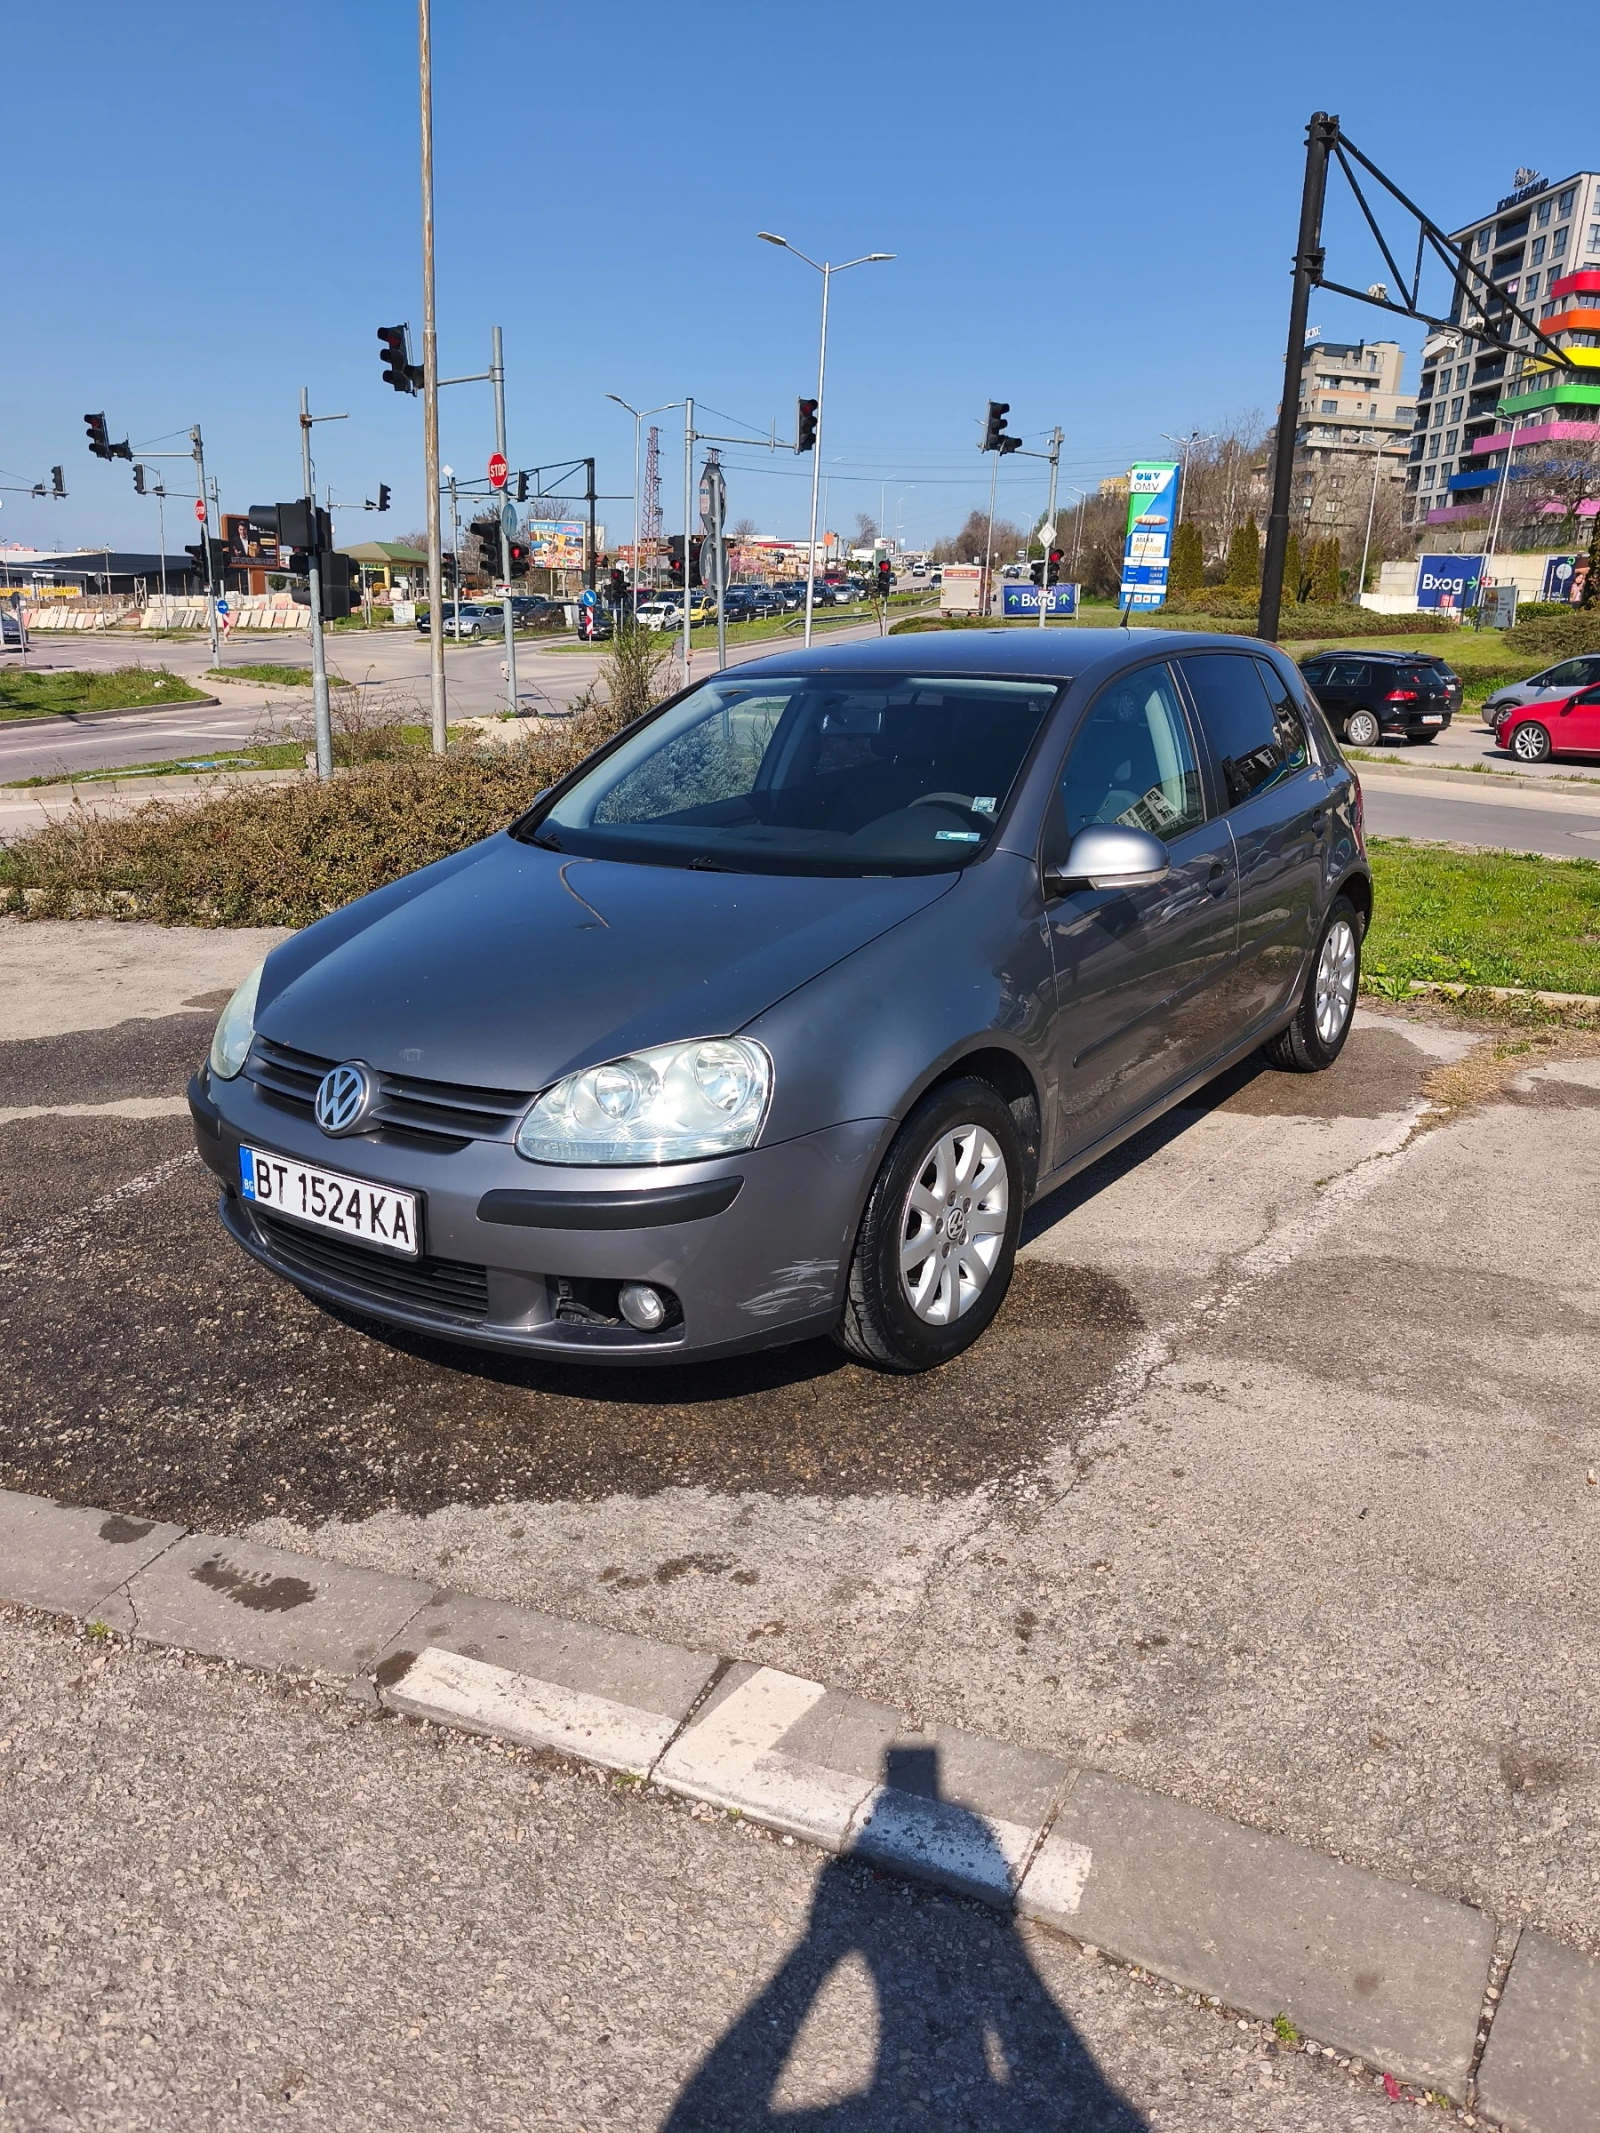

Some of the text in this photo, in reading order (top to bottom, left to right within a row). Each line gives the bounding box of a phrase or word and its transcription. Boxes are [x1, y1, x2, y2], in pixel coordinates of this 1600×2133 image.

[490, 464, 507, 477] STOP
[1134, 483, 1159, 491] OMV
[1141, 516, 1161, 524] VIVA
[243, 1158, 410, 1244] BG BT 1524 KA
